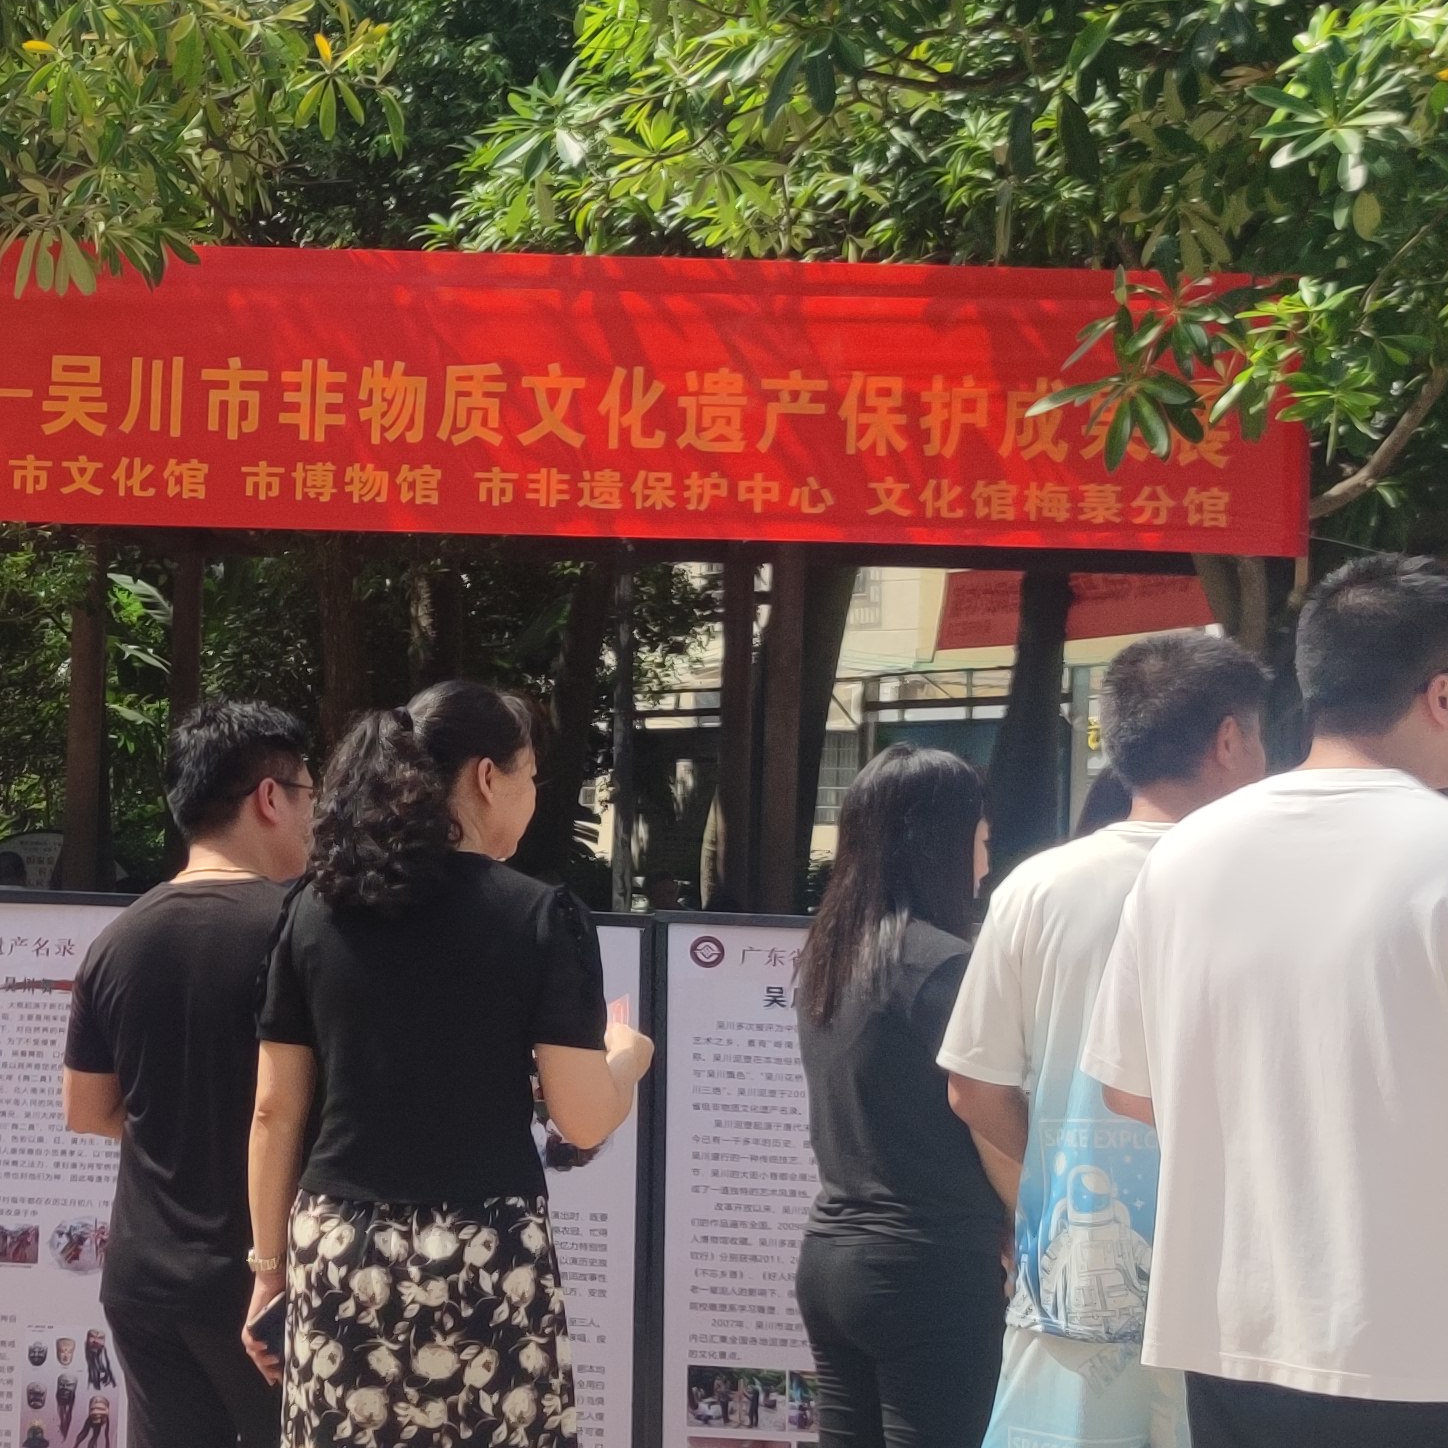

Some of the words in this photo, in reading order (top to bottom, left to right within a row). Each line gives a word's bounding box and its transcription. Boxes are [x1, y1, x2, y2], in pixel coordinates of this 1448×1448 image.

[9, 455, 209, 500] 市文化馆
[243, 460, 441, 505] 市博物馆
[477, 466, 833, 513] 市非遗保护中心
